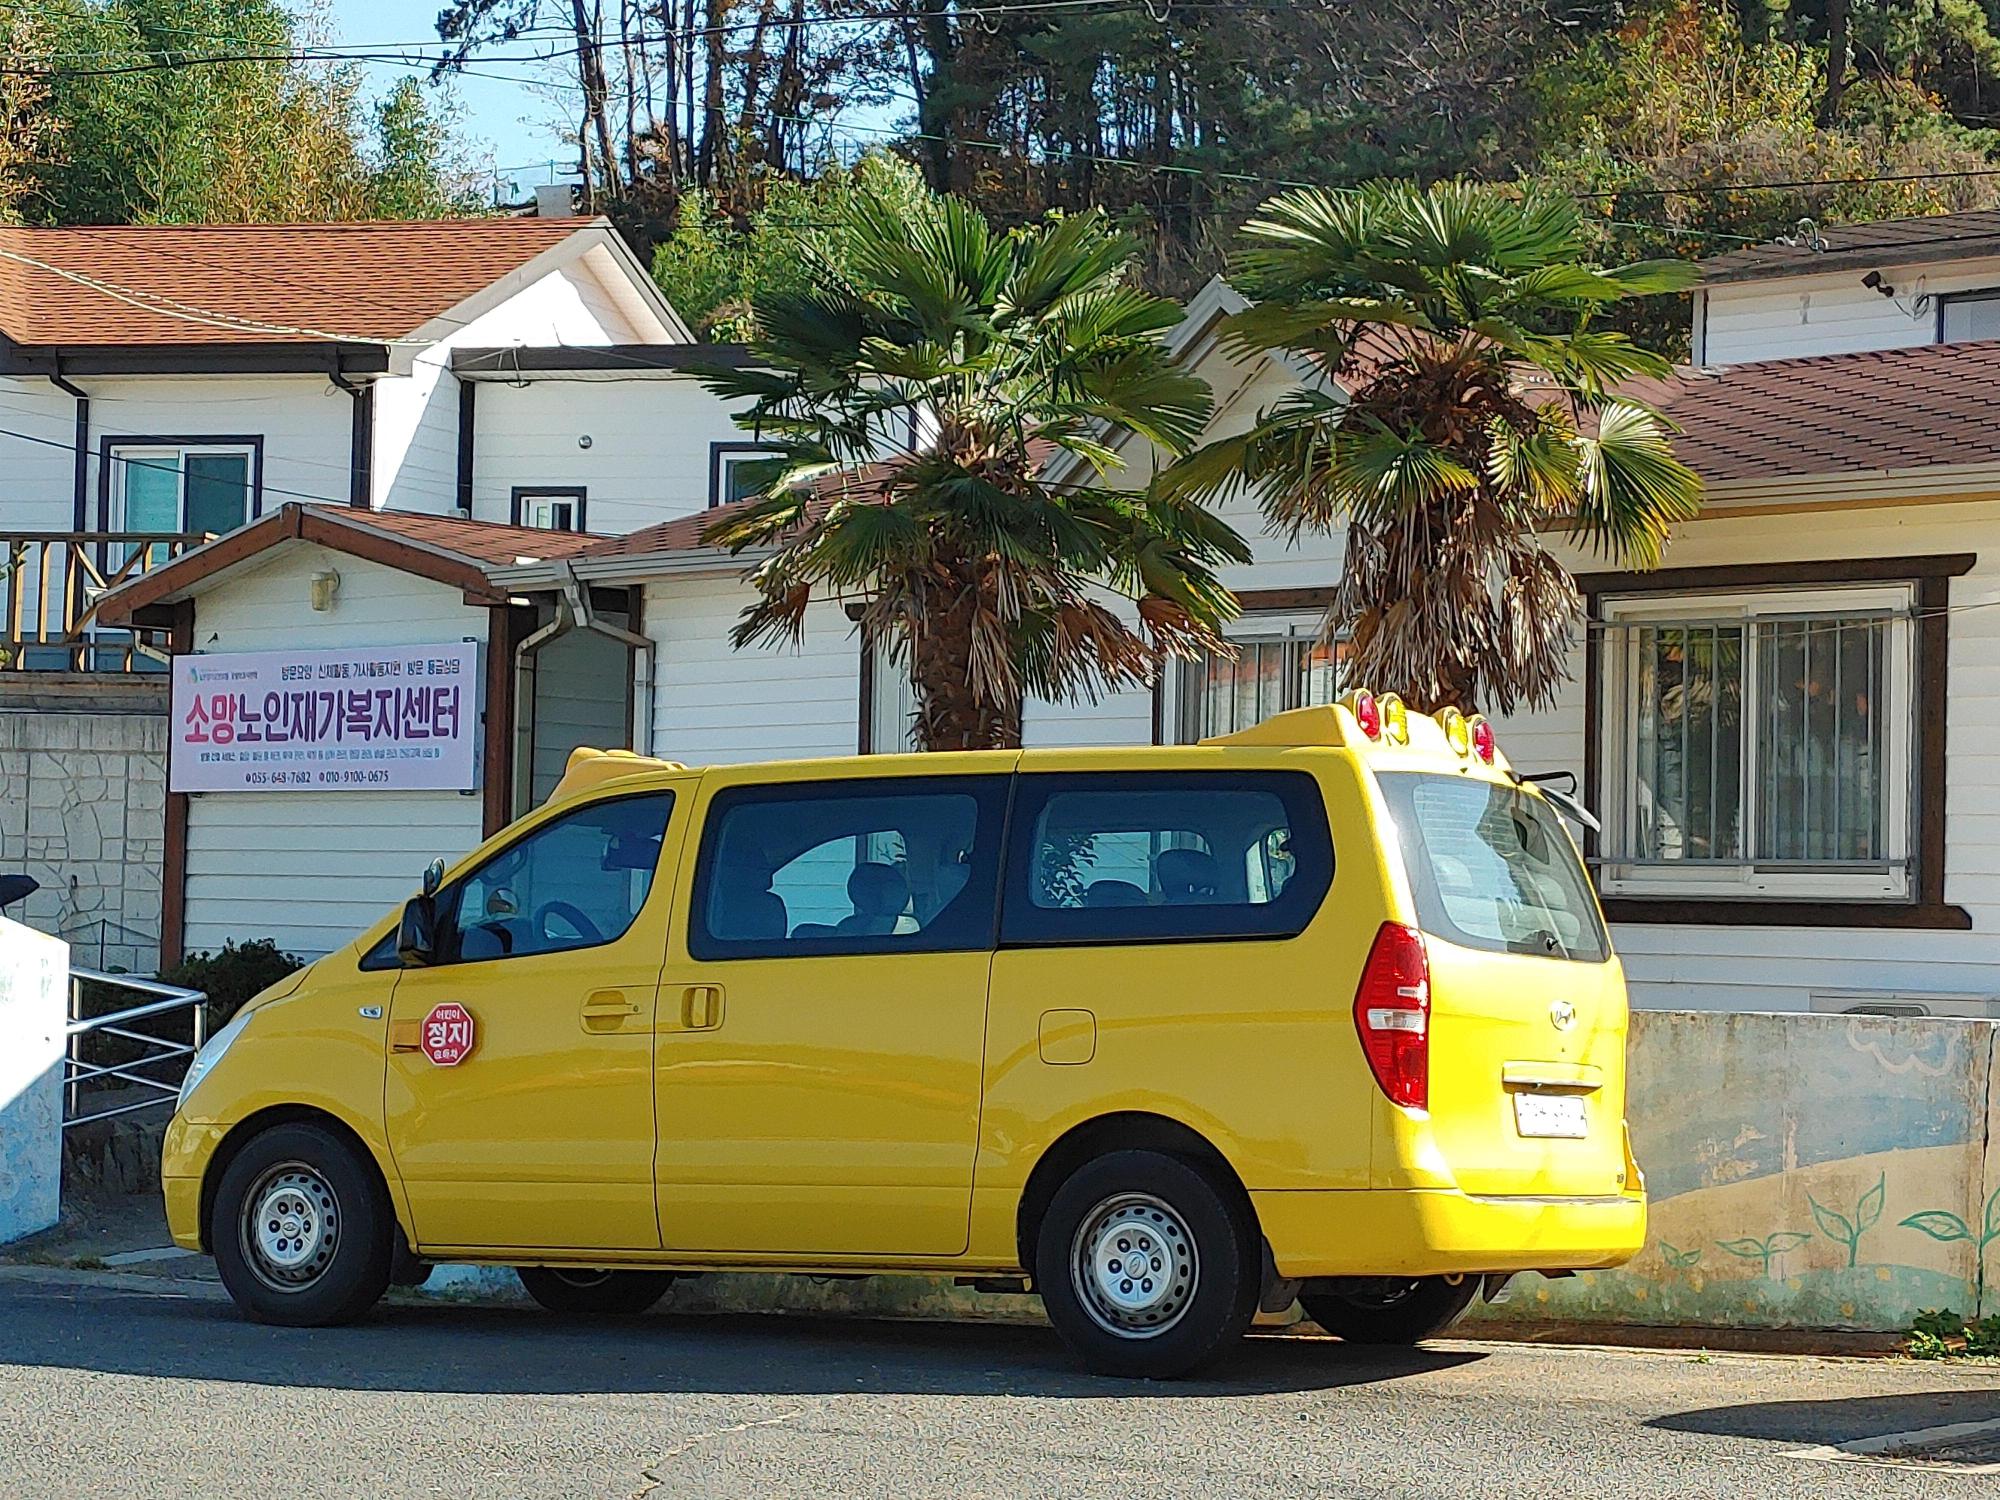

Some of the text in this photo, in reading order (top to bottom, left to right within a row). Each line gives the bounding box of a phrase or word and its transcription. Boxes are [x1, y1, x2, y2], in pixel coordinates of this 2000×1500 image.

[185, 685, 460, 744] 소망노인재가복지센터
[436, 1009, 460, 1020] 어린이
[428, 1020, 468, 1047] 정지
